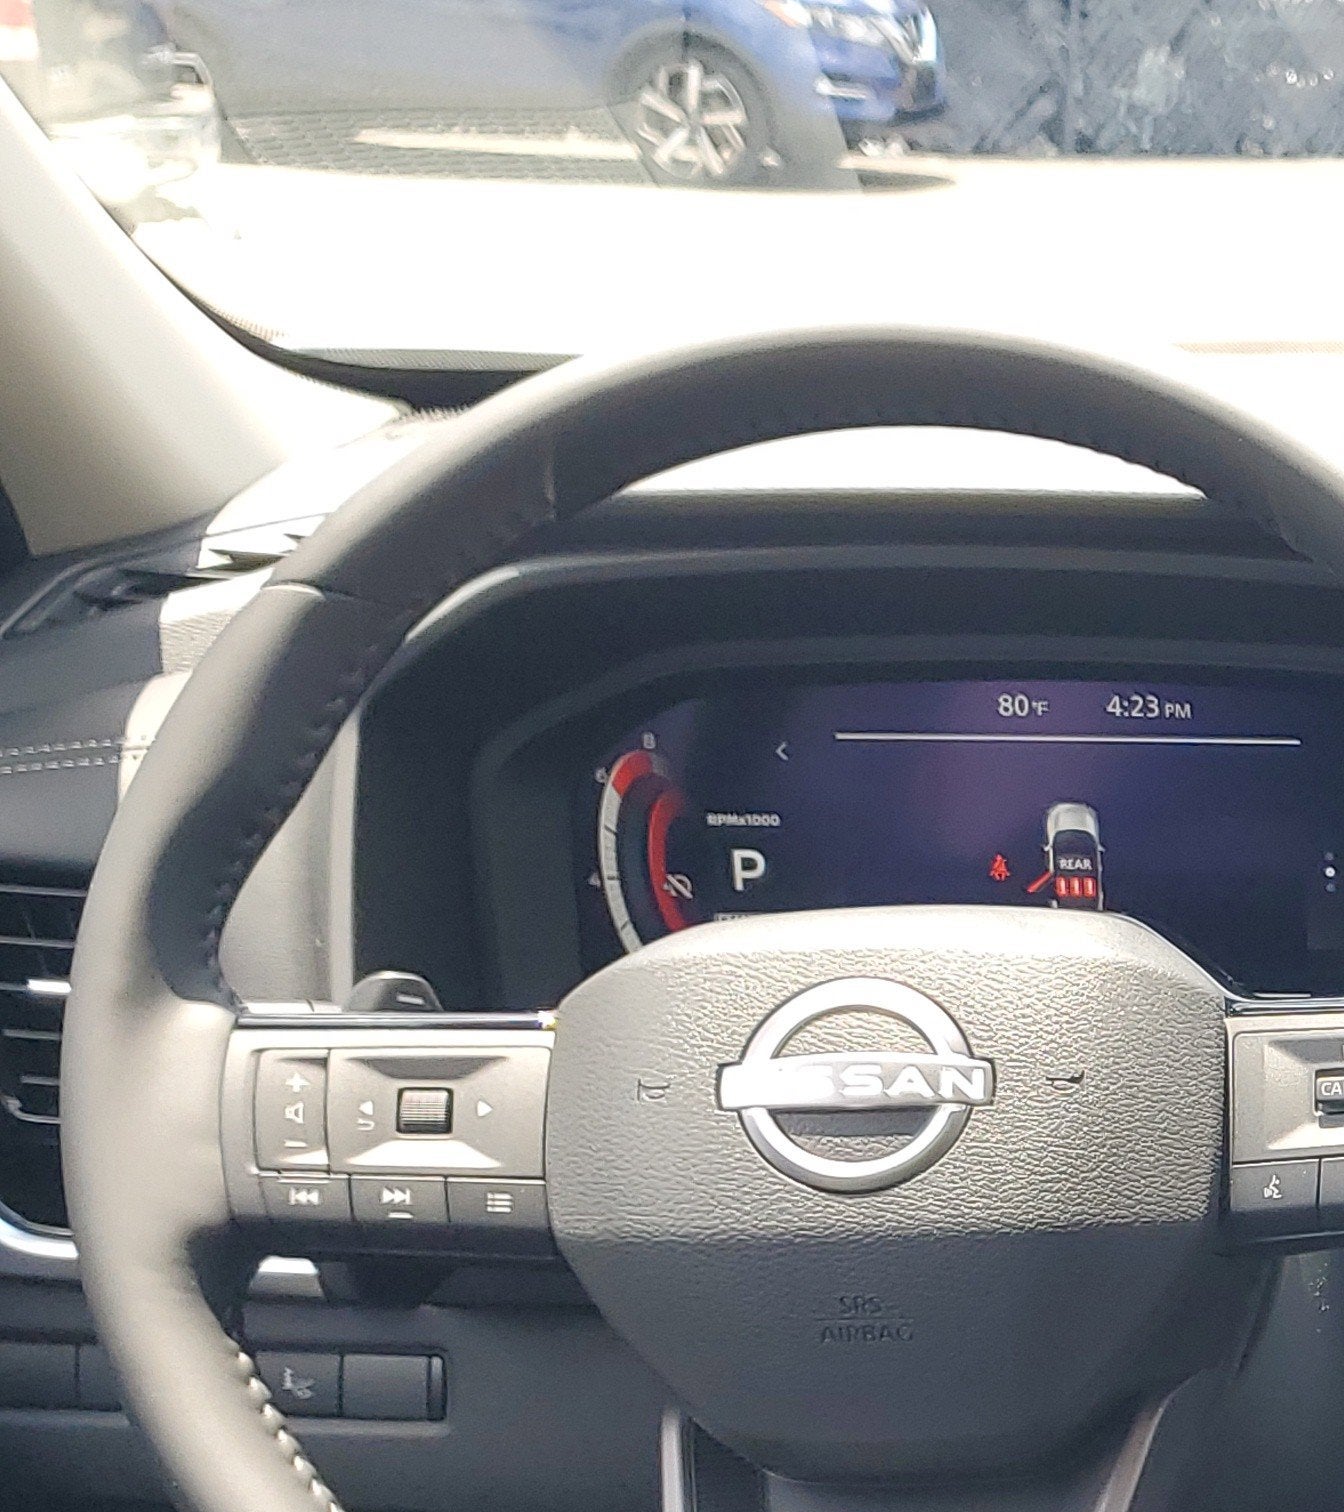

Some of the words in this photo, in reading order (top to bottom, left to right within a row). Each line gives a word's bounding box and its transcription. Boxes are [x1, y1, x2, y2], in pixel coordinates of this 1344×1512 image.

[1105, 693, 1160, 718] 4:23
[1164, 703, 1192, 719] PM
[731, 848, 766, 892] P
[1058, 858, 1093, 871] REAR
